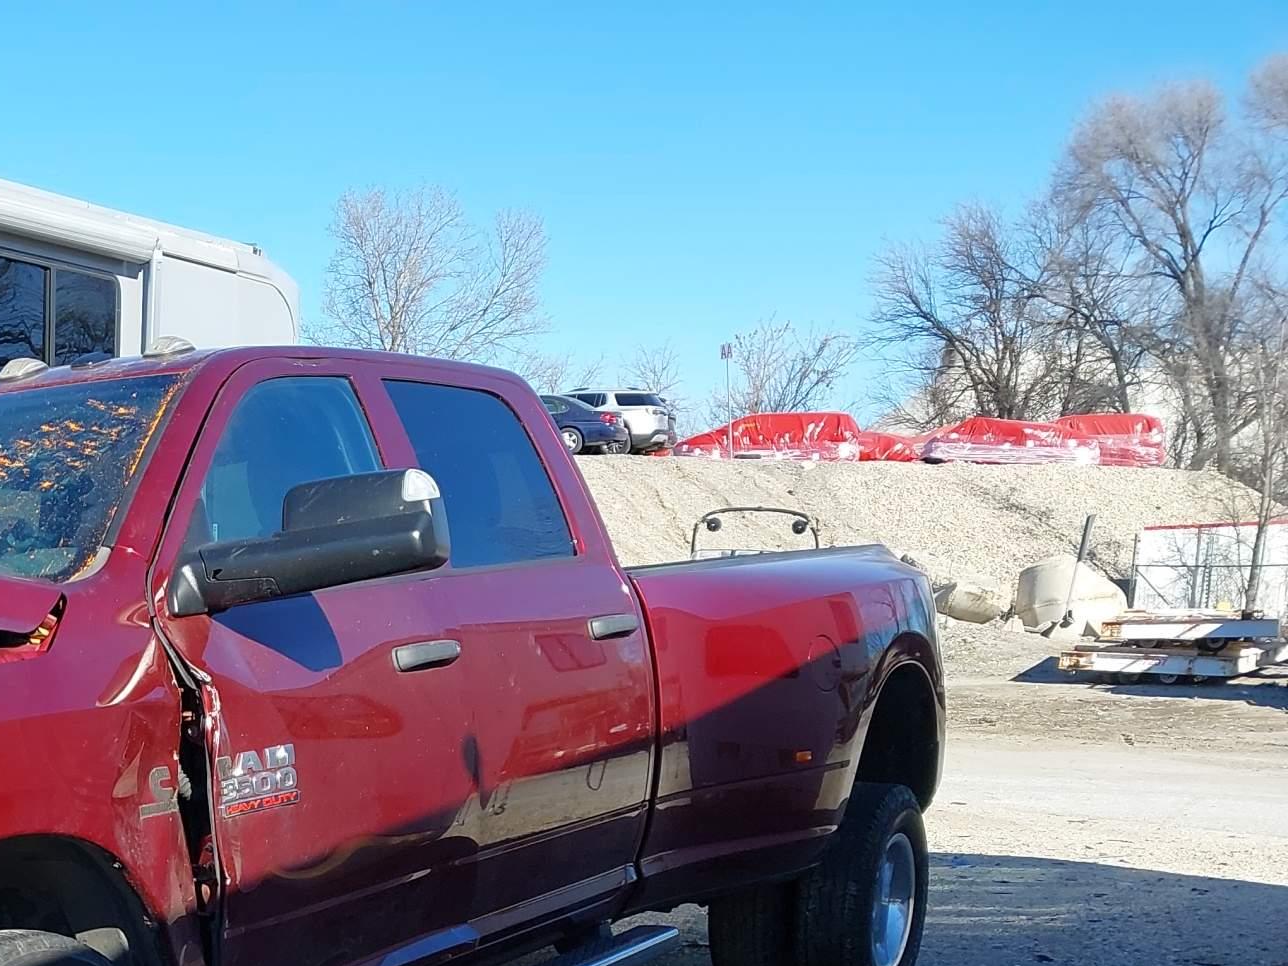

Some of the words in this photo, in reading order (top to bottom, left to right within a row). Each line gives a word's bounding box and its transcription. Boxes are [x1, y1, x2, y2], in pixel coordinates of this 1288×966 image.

[216, 743, 295, 780] RAM
[221, 766, 298, 802] 3500
[226, 799, 262, 815] HEAVY
[262, 791, 298, 807] DUTY
